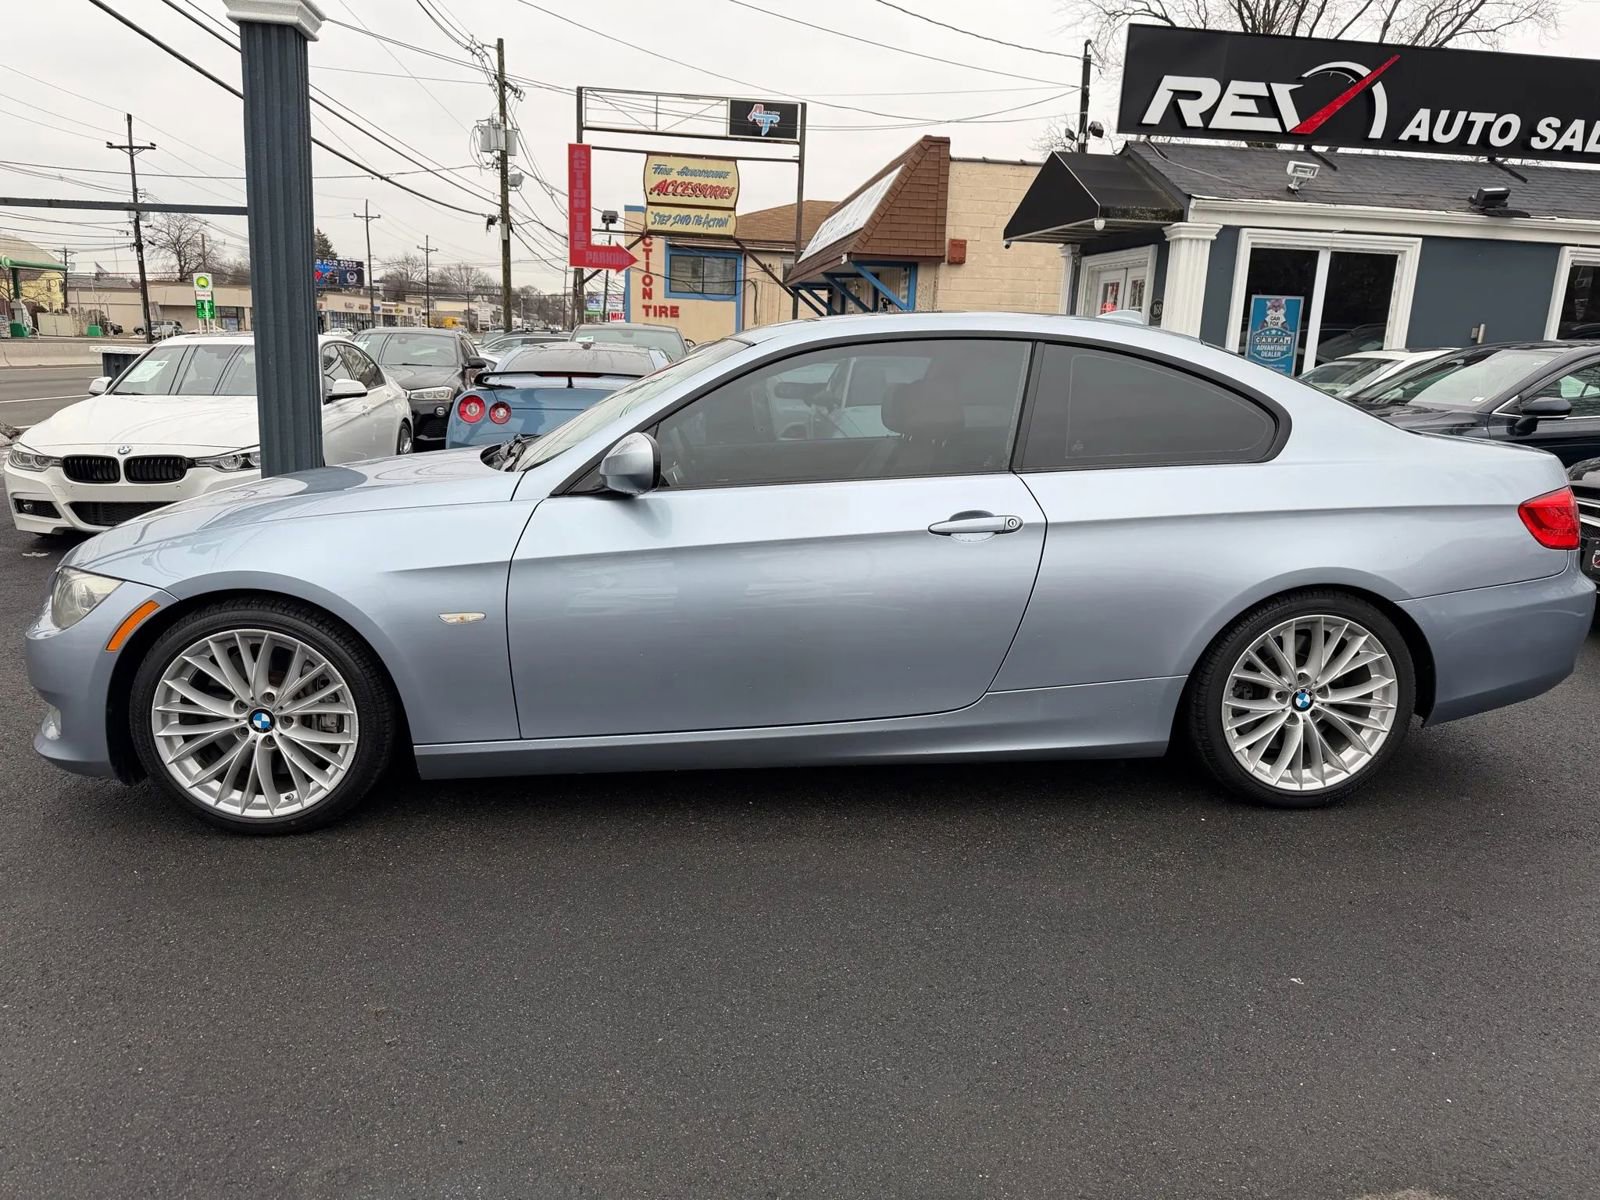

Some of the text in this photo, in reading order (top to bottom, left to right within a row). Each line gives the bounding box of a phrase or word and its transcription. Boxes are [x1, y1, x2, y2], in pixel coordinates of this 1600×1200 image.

[1399, 108, 1522, 148] AUTO
[649, 179, 736, 200] ACCESSORIES
[642, 236, 653, 300] CTION
[642, 305, 680, 318] TIRE
